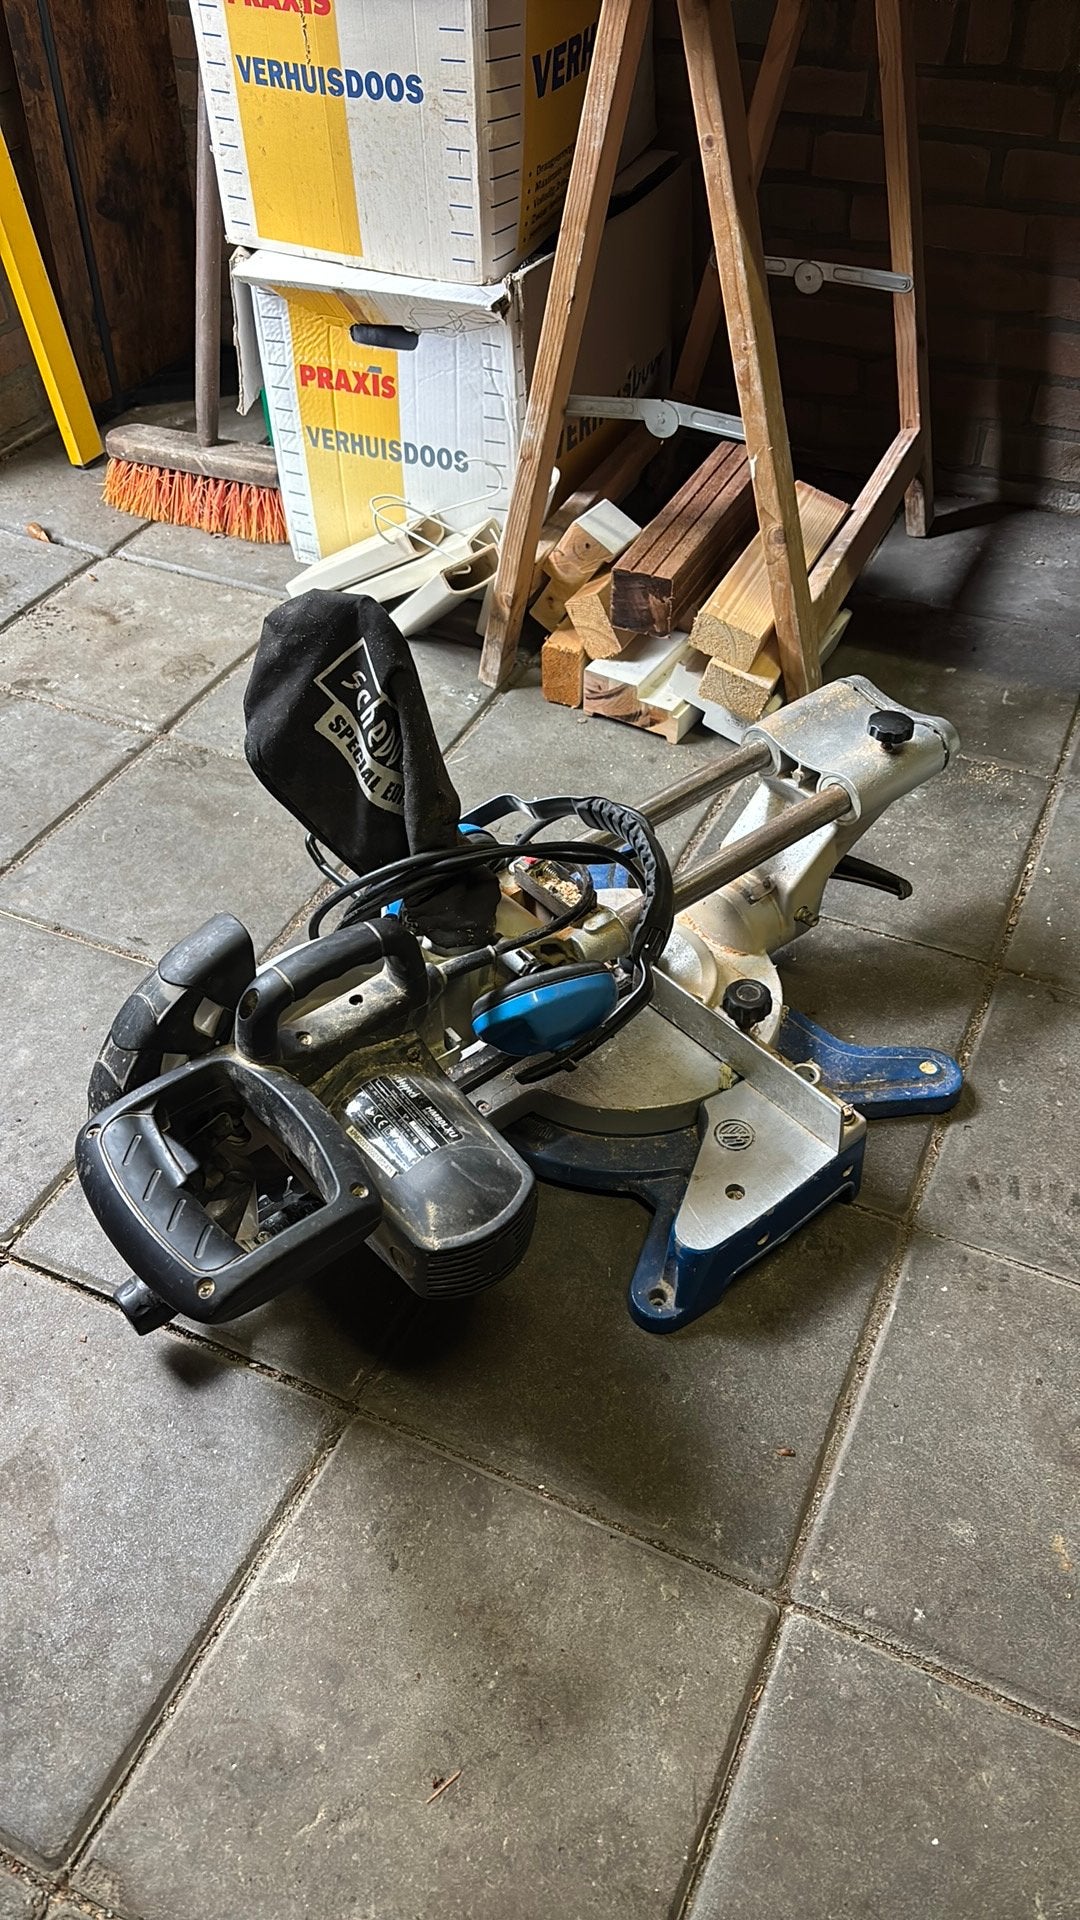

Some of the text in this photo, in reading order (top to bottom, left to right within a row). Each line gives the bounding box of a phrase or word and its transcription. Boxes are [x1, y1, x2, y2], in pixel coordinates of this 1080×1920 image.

[236, 54, 424, 104] VERHUISDOOS
[299, 364, 397, 399] PRAXIS
[306, 425, 469, 473] VERHUISDOOS
[328, 714, 381, 793] SPECIAL
